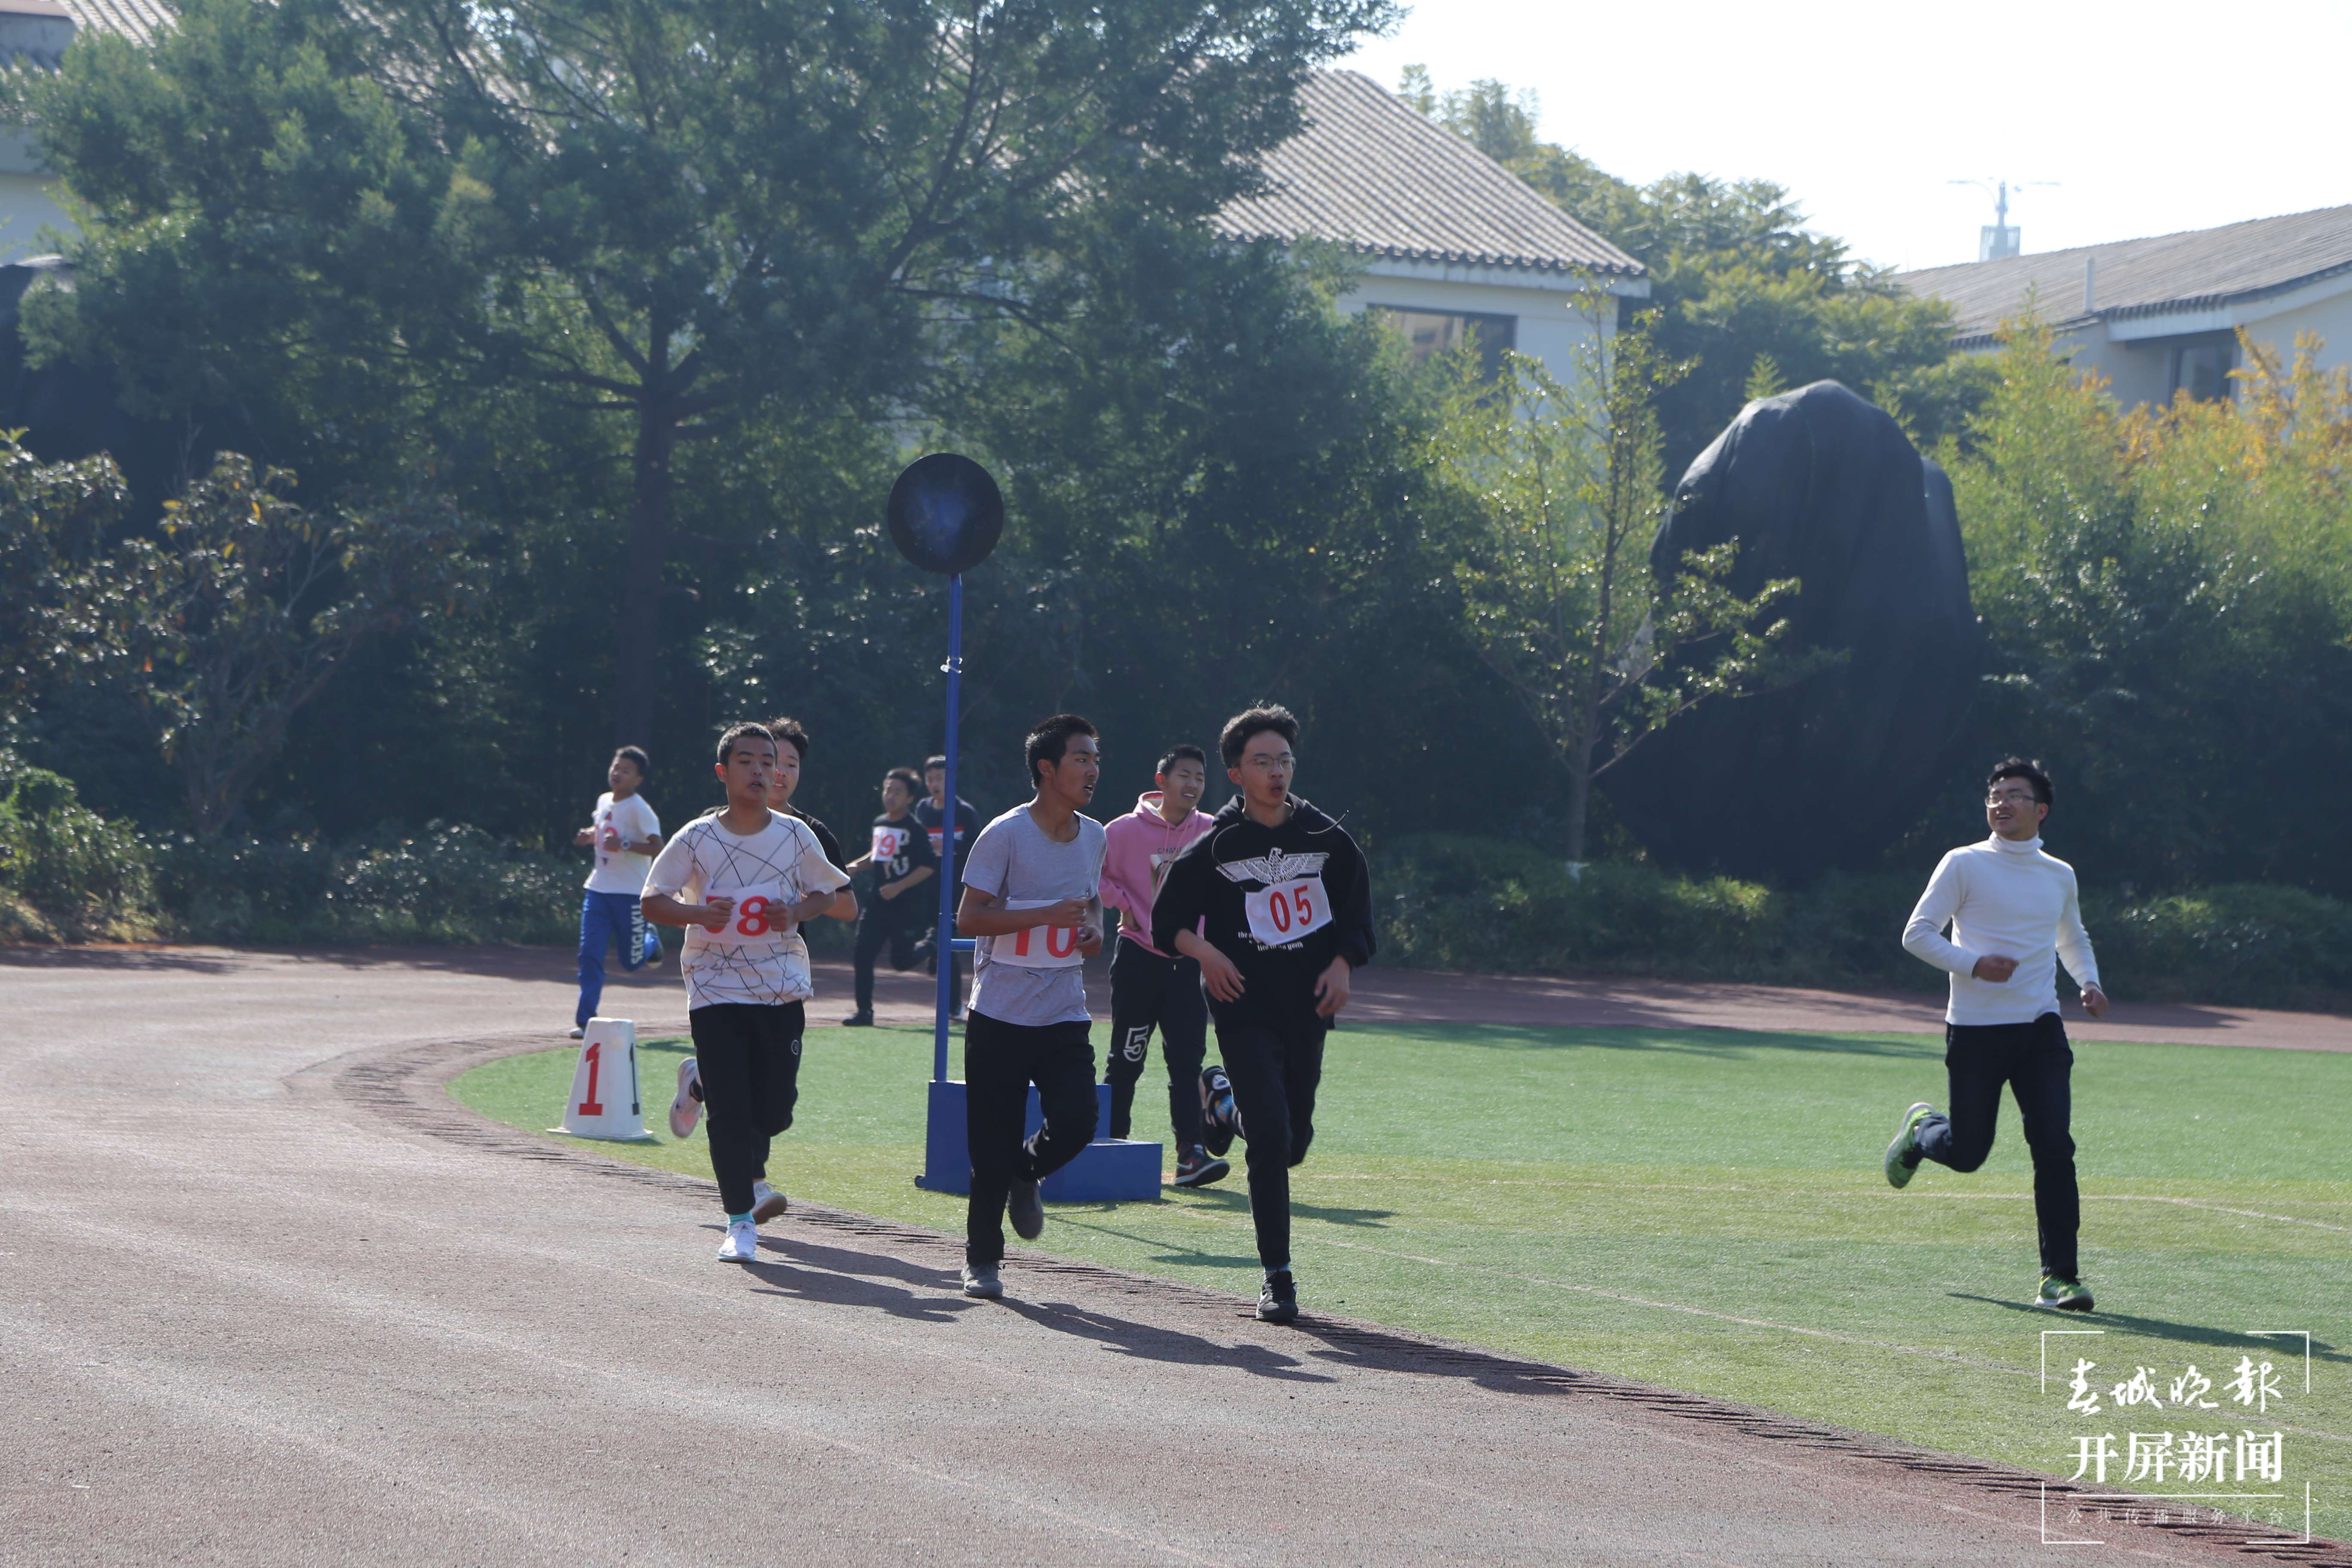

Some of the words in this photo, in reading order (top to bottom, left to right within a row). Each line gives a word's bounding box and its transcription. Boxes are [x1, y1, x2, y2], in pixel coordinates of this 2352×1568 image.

[1270, 885, 1313, 933] 05
[1123, 1024, 1149, 1062] 5
[579, 1042, 603, 1116] 1
